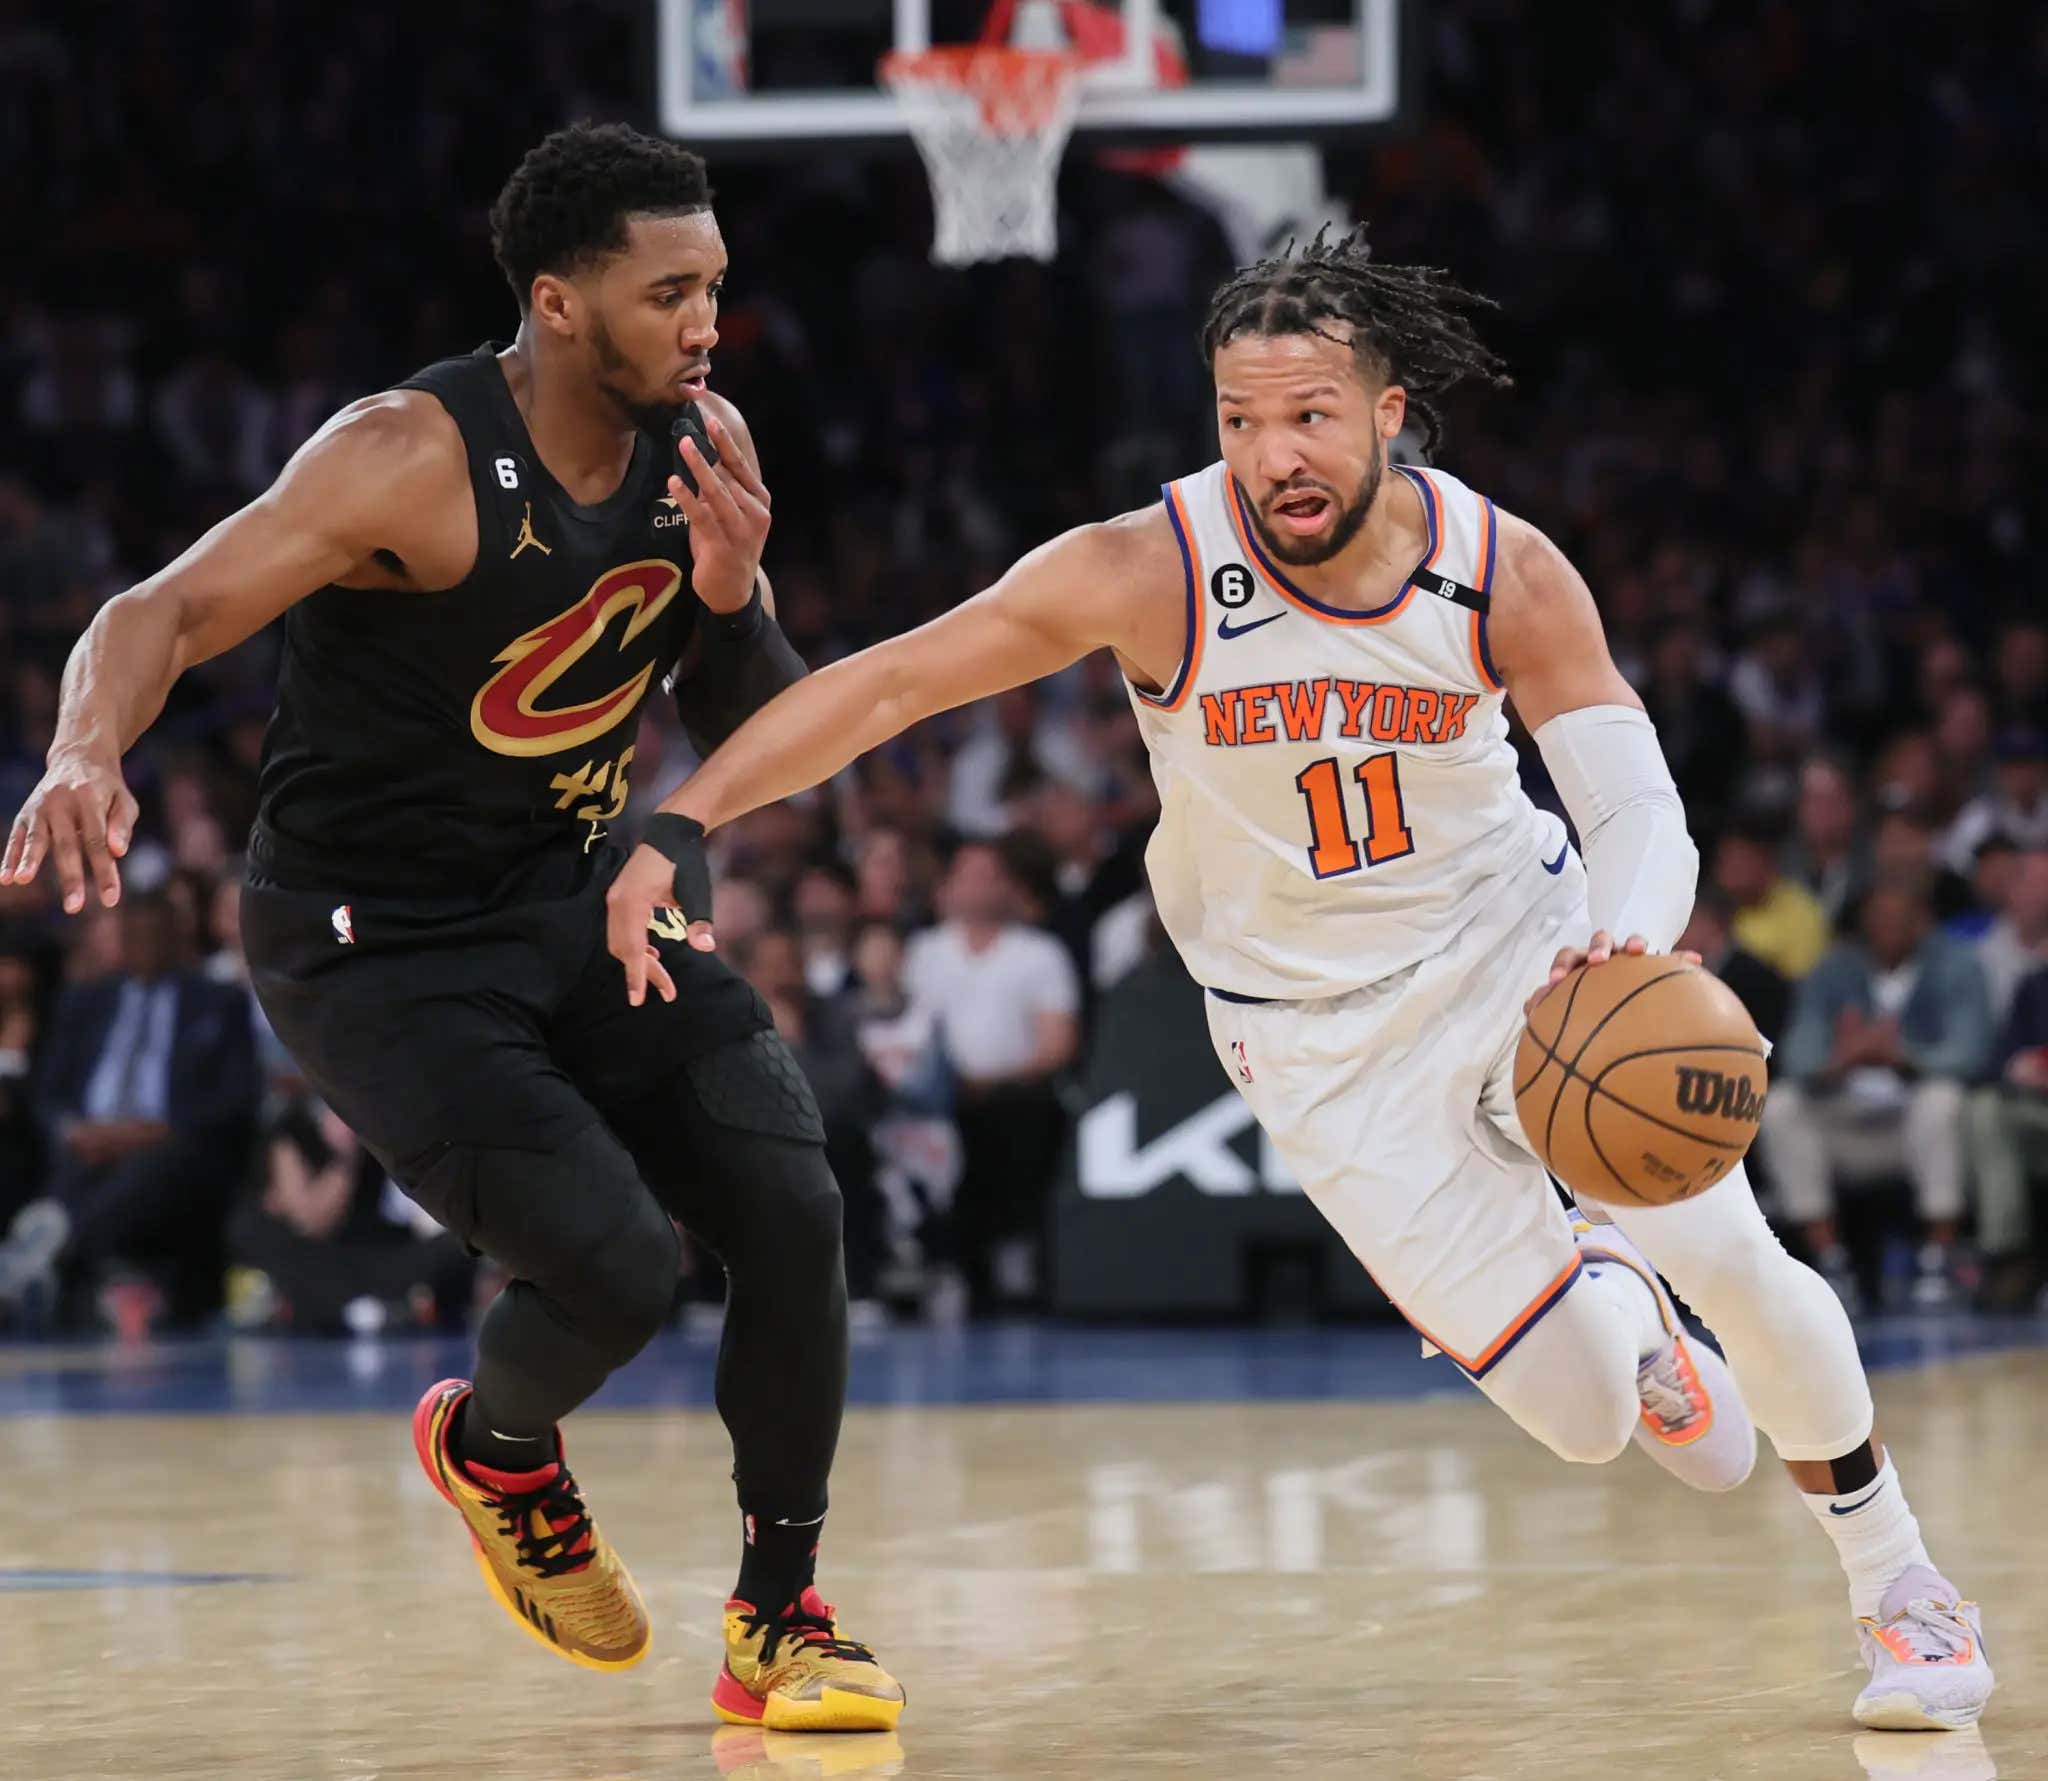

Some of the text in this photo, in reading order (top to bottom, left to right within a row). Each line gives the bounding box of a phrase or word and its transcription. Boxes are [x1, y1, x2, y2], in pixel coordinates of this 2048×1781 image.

[495, 457, 519, 489] 6
[1221, 569, 1245, 603] 6
[1438, 580, 1456, 598] 19
[1199, 678, 1481, 746] NEW YORK
[1295, 751, 1415, 880] 11
